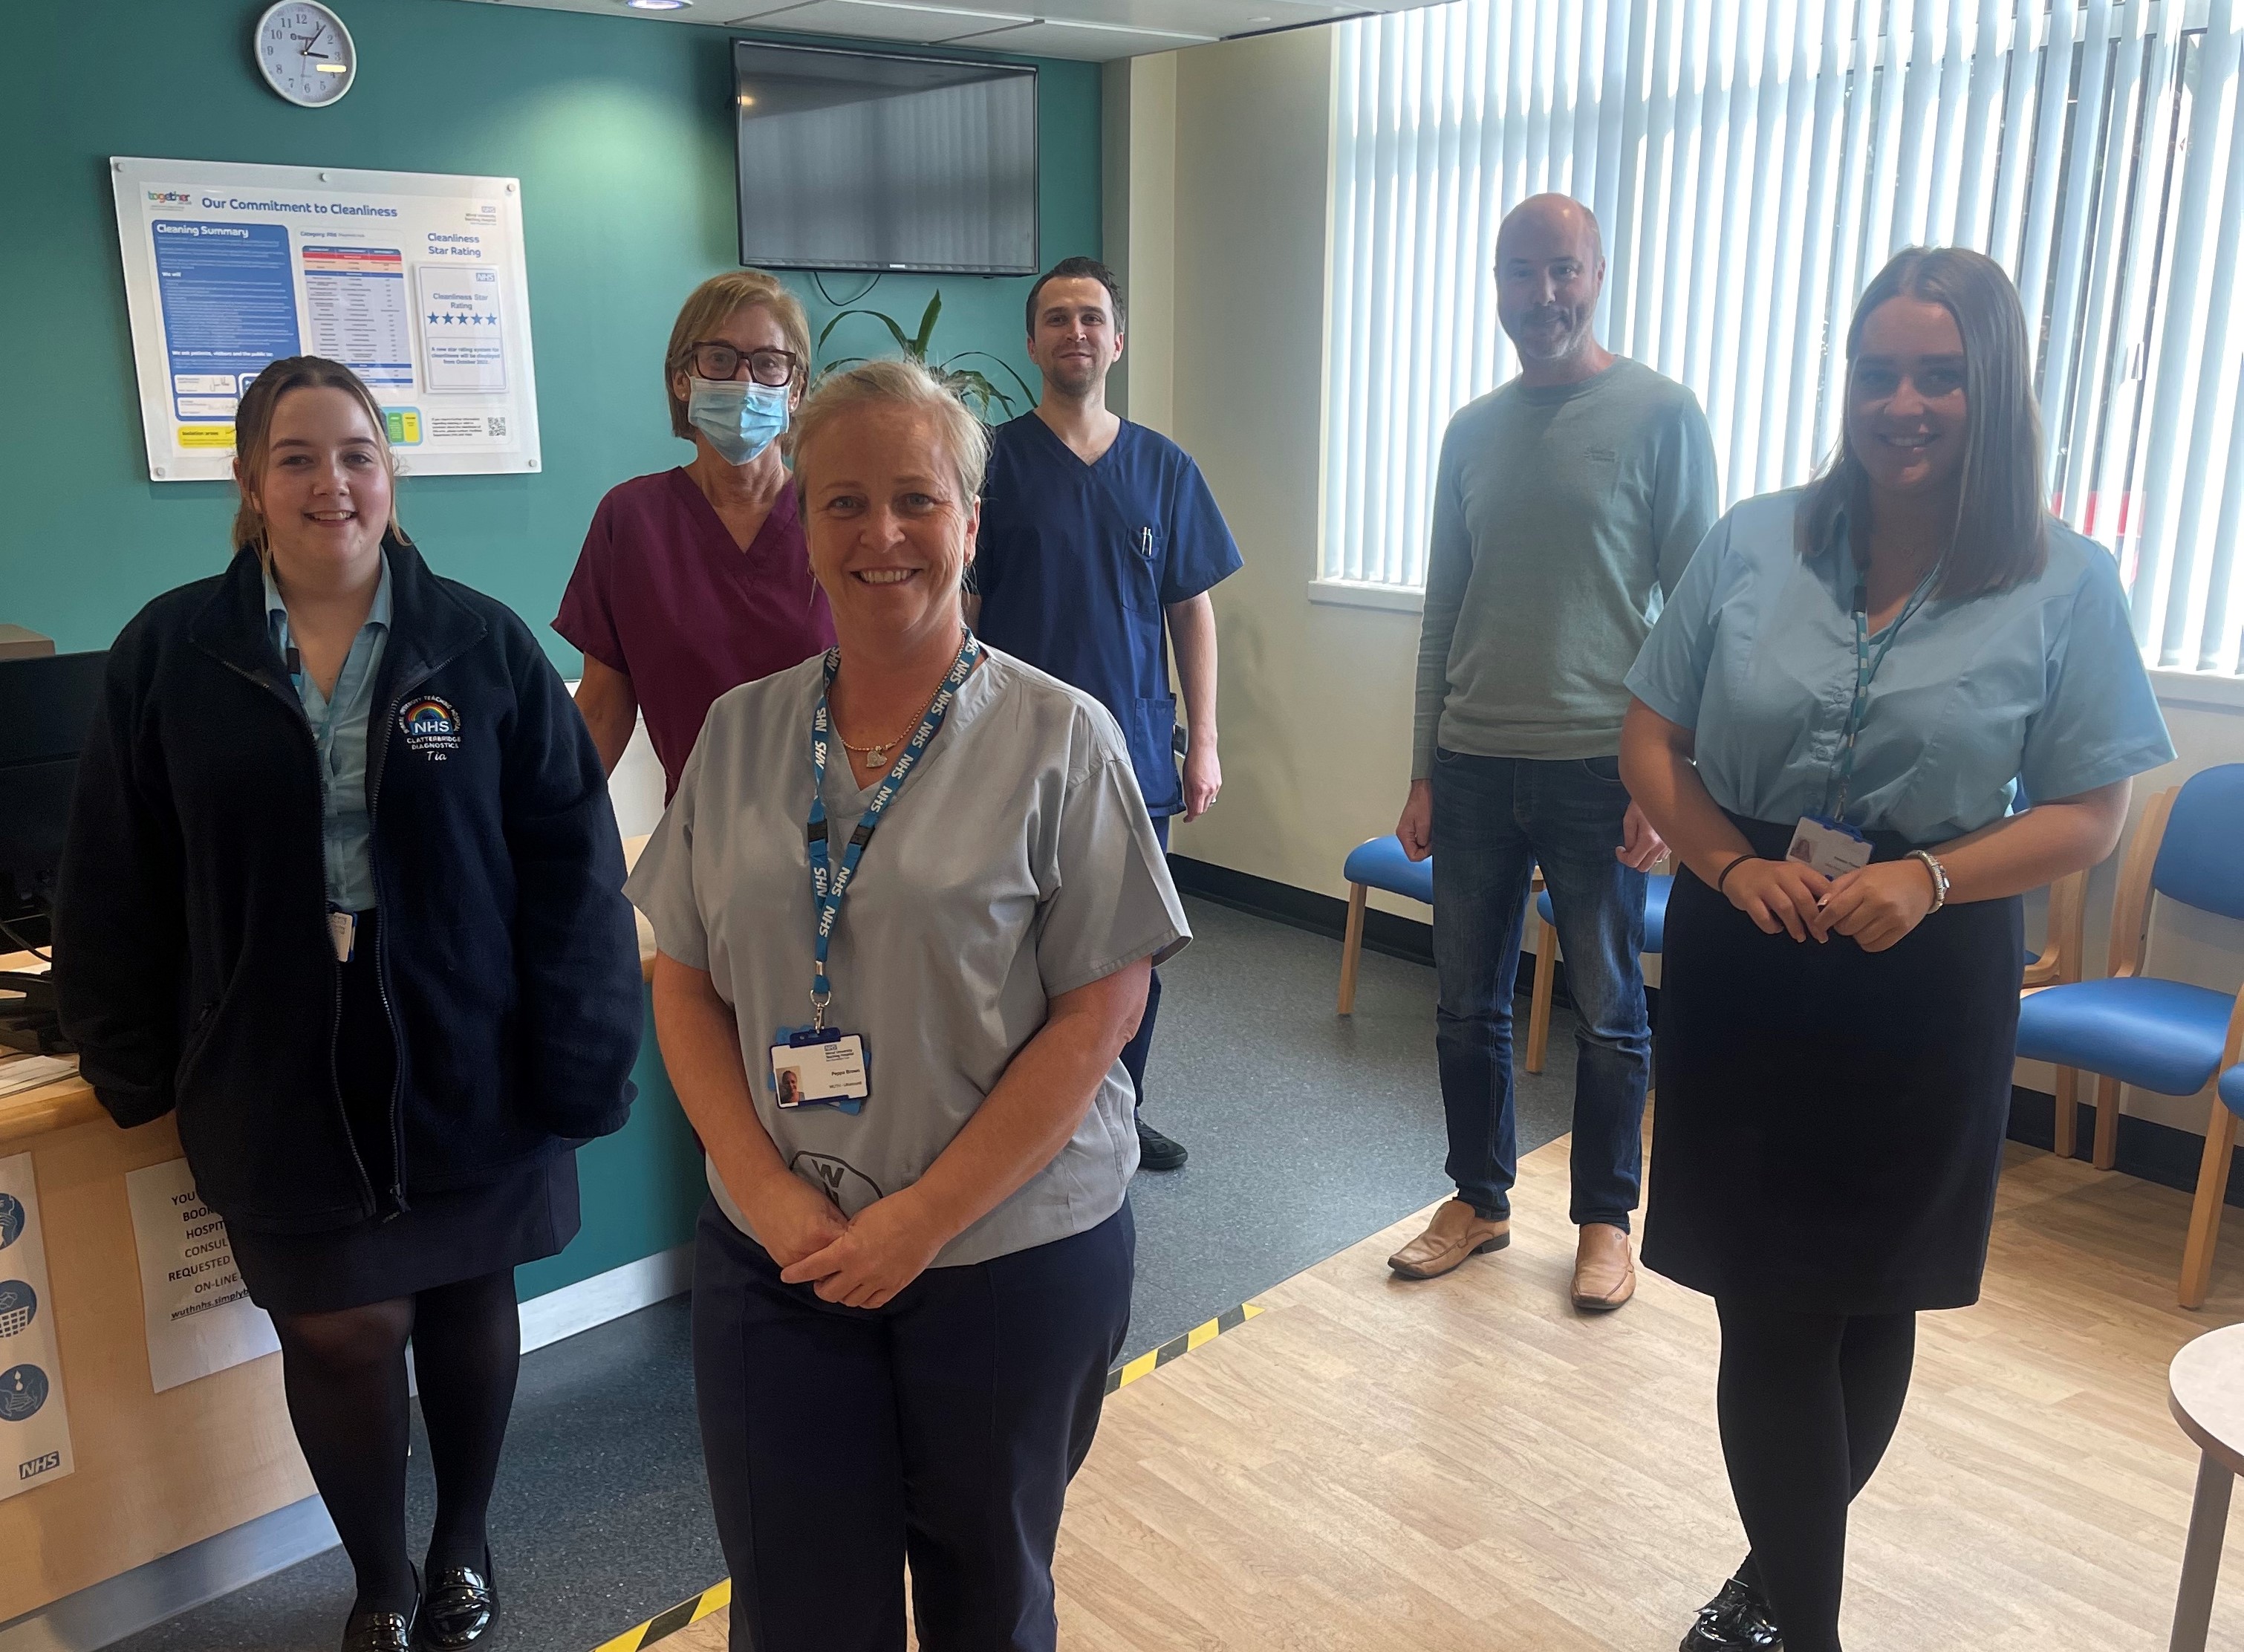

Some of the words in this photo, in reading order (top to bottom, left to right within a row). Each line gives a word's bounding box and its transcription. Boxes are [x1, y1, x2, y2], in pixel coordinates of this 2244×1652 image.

[281, 17, 292, 28] 11
[296, 13, 308, 25] 12
[270, 29, 282, 40] 10
[327, 34, 334, 45] 2
[267, 45, 273, 56] 9
[334, 51, 341, 60] 3
[276, 64, 282, 74] 8
[288, 78, 294, 88] 7
[304, 82, 310, 94] 6
[319, 80, 326, 91] 5
[201, 196, 227, 209] Our
[230, 198, 312, 214] Commitment
[314, 202, 328, 214] to
[331, 204, 398, 217] Cleanliness
[156, 224, 199, 237] Cleaning
[201, 225, 249, 238] Summary
[427, 232, 480, 243] Cleanliness
[428, 246, 449, 255] Star
[451, 247, 481, 258] Rating
[476, 273, 495, 282] NHS
[450, 302, 472, 310] Rating
[949, 659, 970, 685] NHS
[423, 695, 452, 709] TEACHING
[931, 689, 952, 716] NHS
[815, 706, 827, 732] NHS
[414, 721, 450, 734] NHS
[406, 735, 461, 744] CLATTERBRIDGE
[912, 721, 934, 749] NHS
[426, 751, 448, 761] Tia
[814, 740, 827, 770] NHS
[891, 753, 914, 780] NHS
[871, 785, 893, 813] NHS
[813, 867, 828, 898] NHS
[831, 866, 851, 897] NHS
[819, 905, 836, 937] NHS
[171, 1191, 195, 1206] YOU
[184, 1238, 228, 1258] CONSUL
[168, 1255, 230, 1281] REQUESTED
[194, 1272, 238, 1293] ON-LINE
[20, 1451, 59, 1480] NHS
